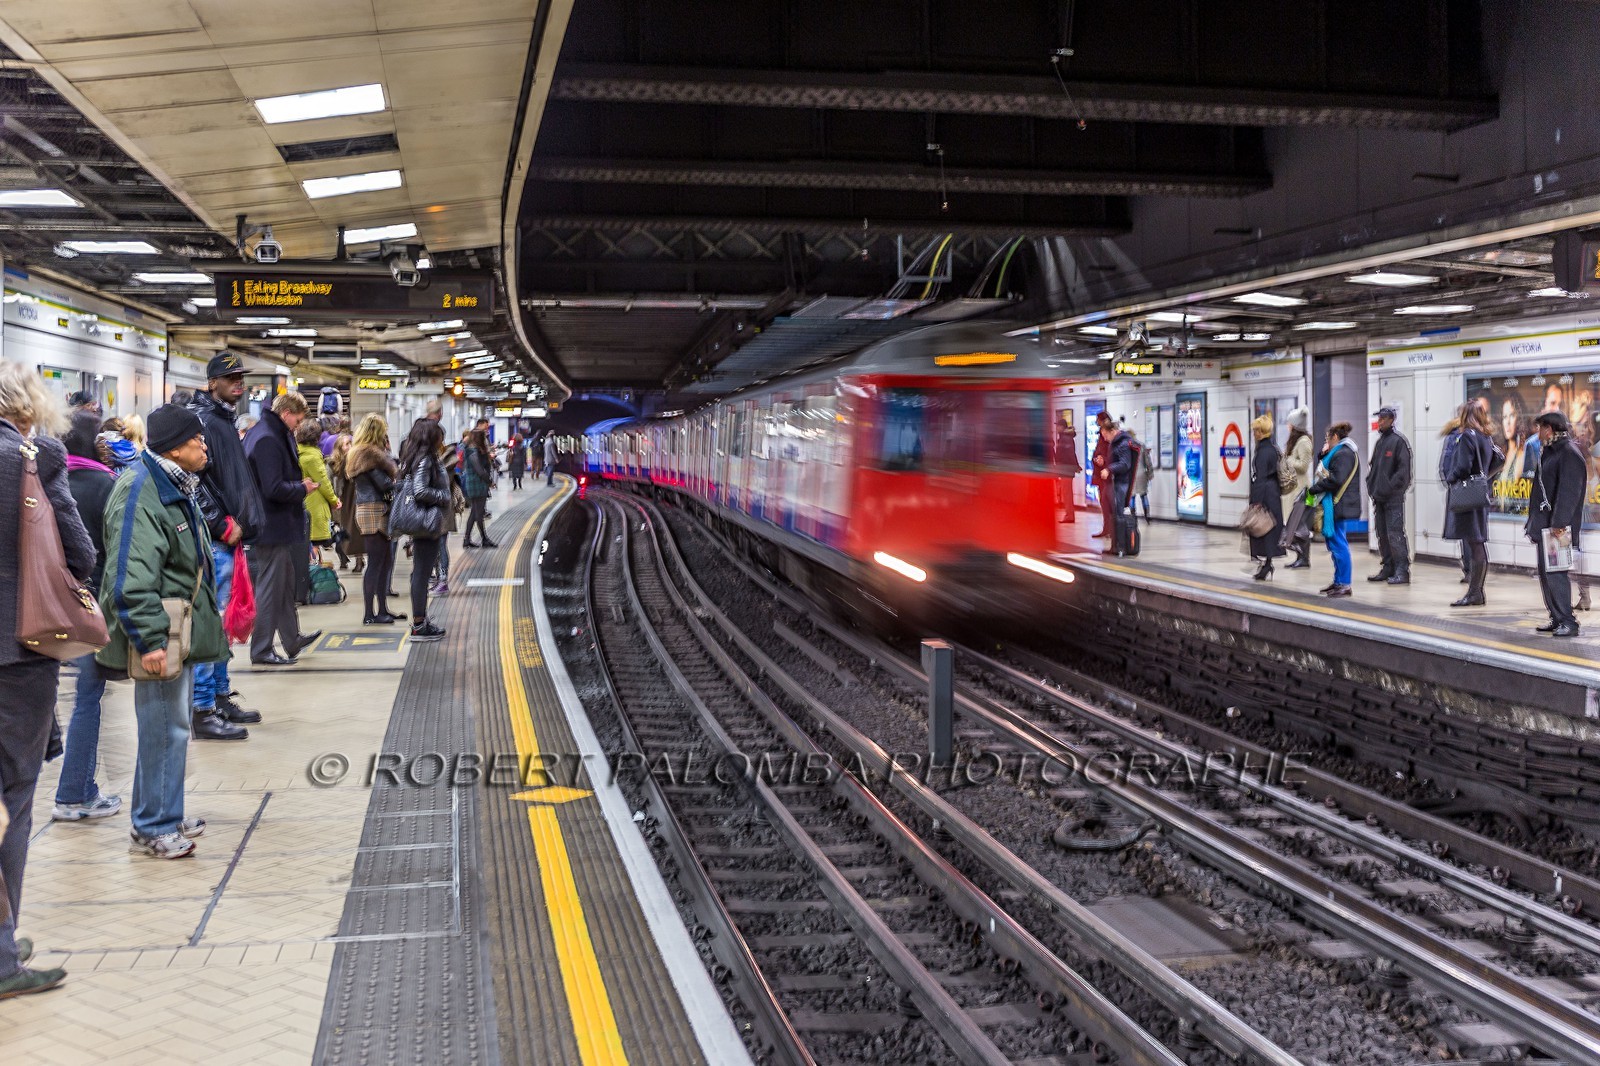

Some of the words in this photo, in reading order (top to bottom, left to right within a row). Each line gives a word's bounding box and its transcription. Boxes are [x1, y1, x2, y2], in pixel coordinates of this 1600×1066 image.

[232, 280, 238, 294] 1
[244, 280, 278, 295] Ealing
[279, 280, 332, 295] Broadway
[232, 293, 241, 306] 2
[244, 293, 303, 306] Wimbledon
[443, 294, 451, 308] 2
[455, 295, 478, 307] mins
[1511, 343, 1542, 355] VICTORIA
[1408, 352, 1433, 364] VICTORIA
